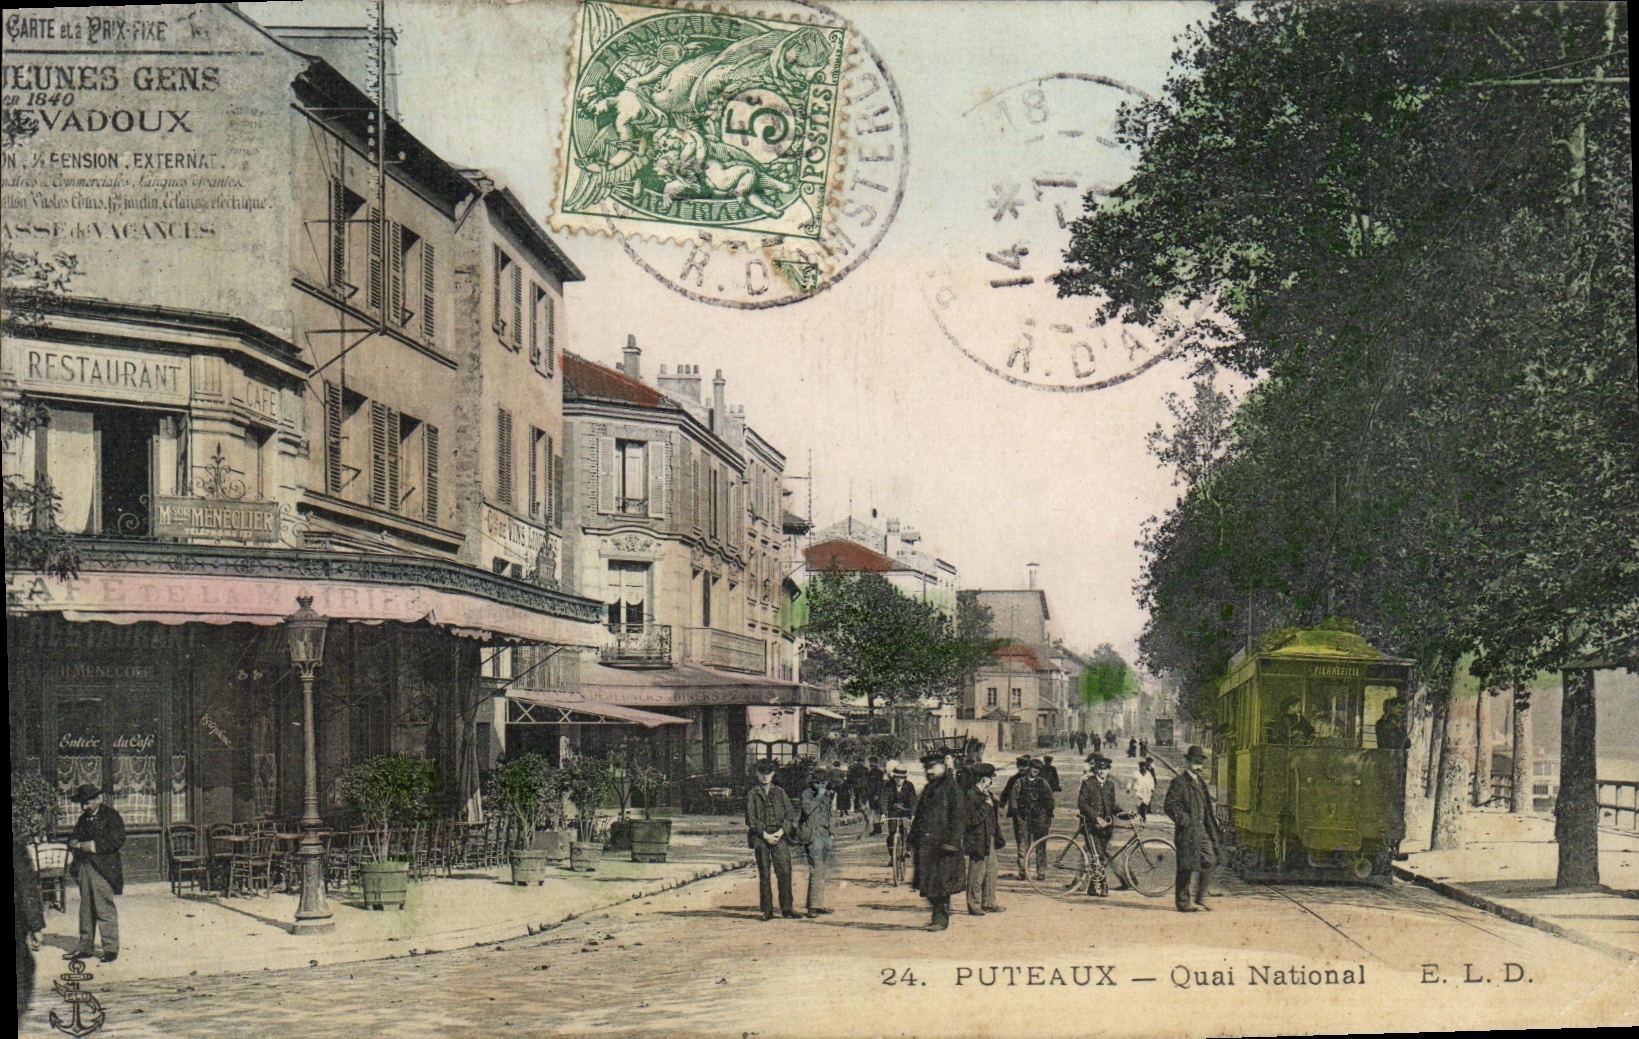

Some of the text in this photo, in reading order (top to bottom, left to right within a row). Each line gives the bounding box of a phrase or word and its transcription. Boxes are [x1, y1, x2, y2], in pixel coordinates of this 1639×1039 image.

[6, 14, 56, 42] CARTE
[133, 65, 220, 92] GENS
[26, 92, 75, 108] 1840
[802, 87, 833, 181] POSTES
[28, 350, 182, 392] RESTAURANT
